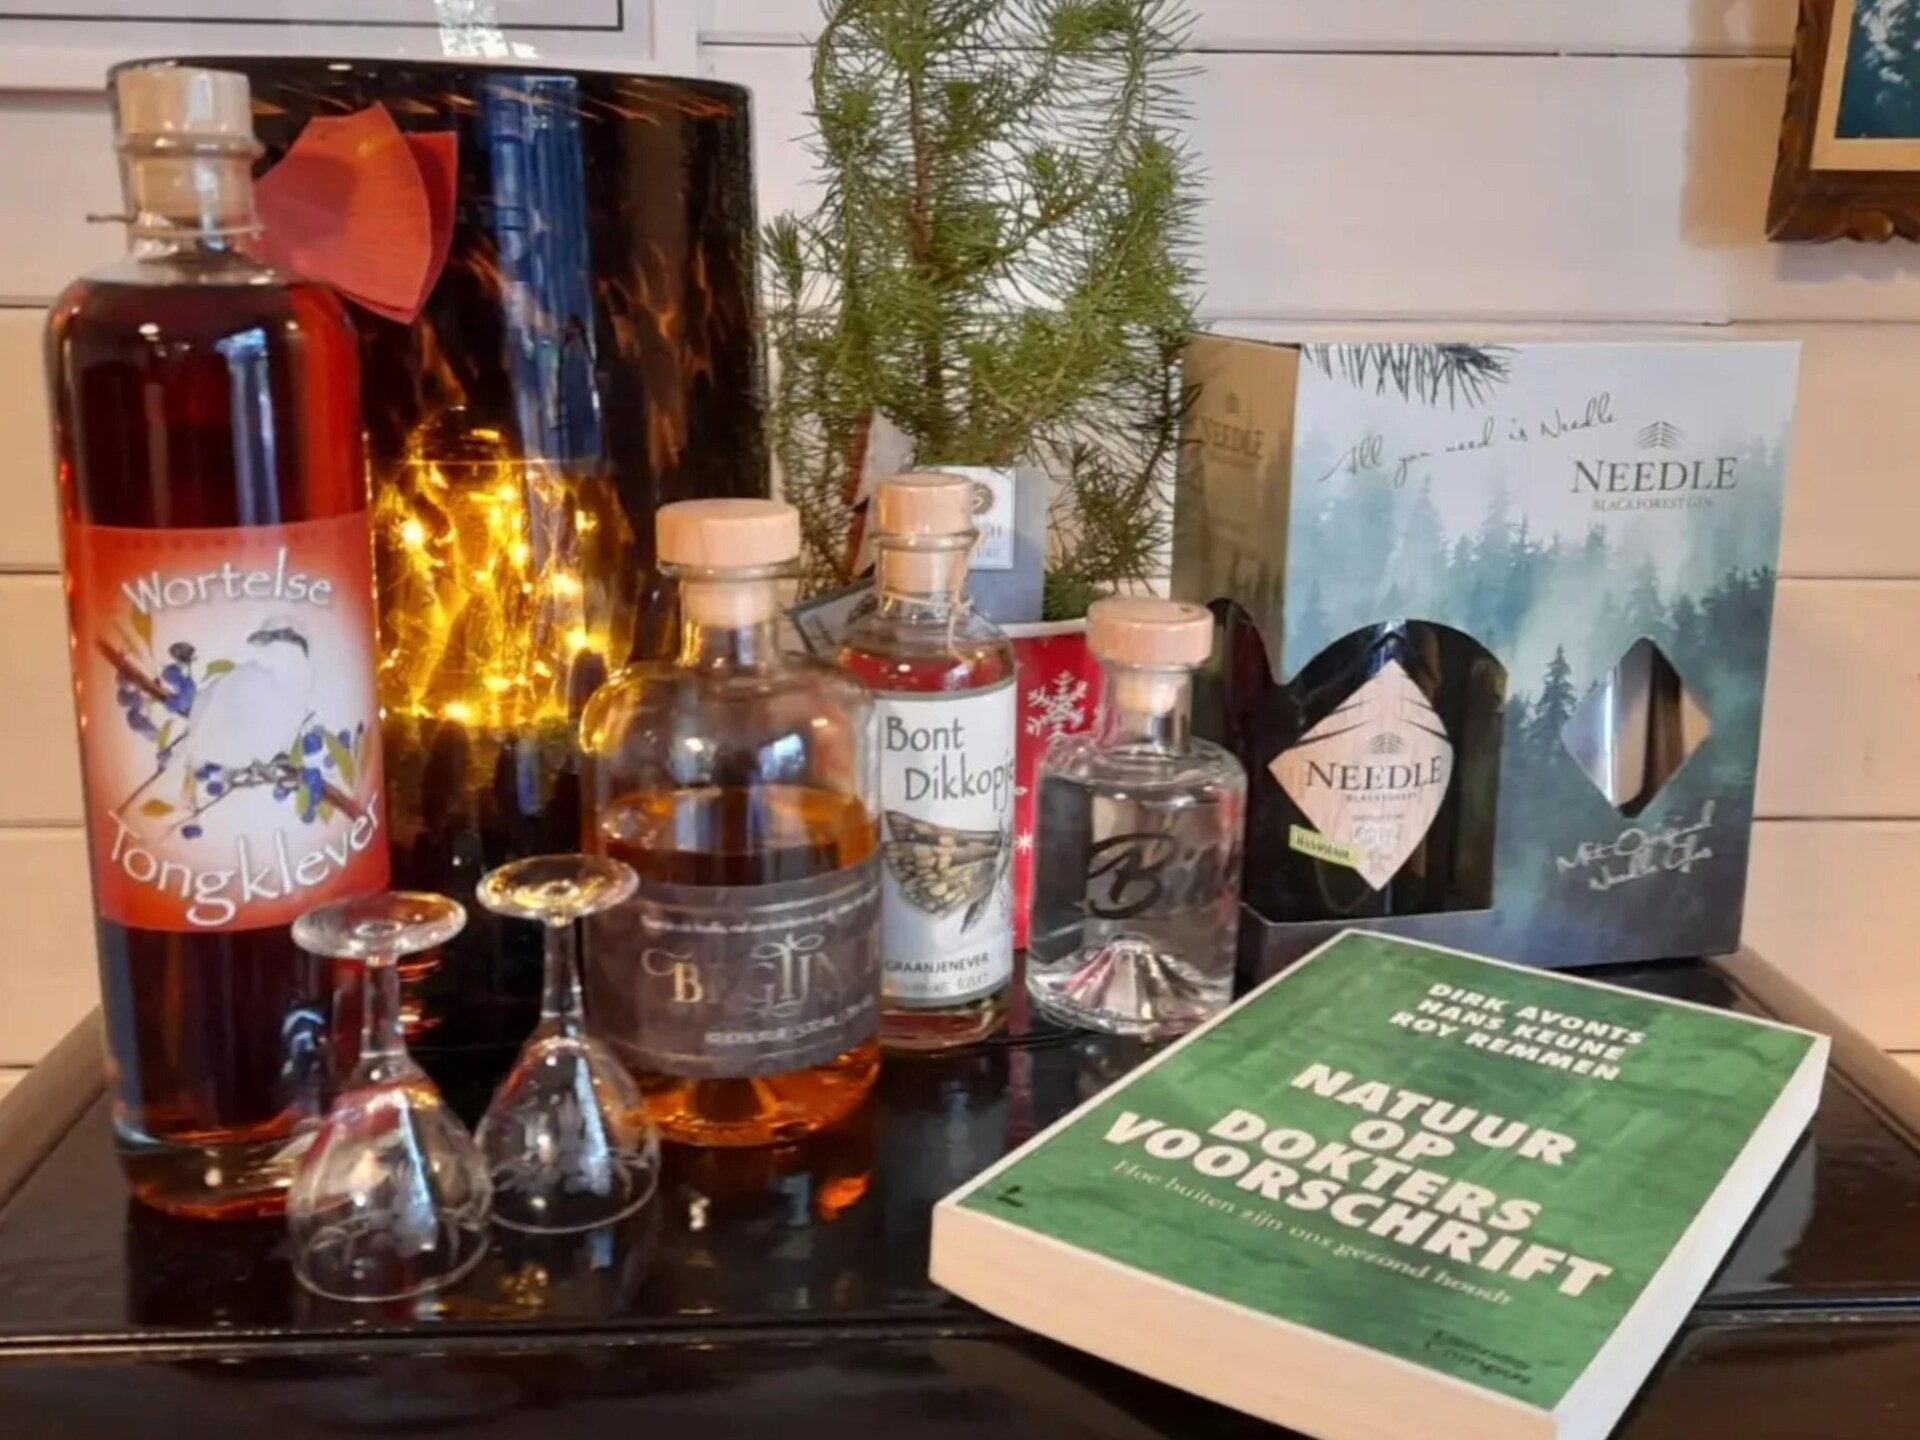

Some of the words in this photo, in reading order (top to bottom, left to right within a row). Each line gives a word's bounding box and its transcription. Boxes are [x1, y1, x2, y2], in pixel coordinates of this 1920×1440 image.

[1201, 416, 1265, 460] NEEDLE
[1540, 393, 1617, 438] Needle
[1570, 456, 1738, 493] NEEDLE
[121, 546, 334, 615] Wortelse
[885, 715, 965, 752] Bont
[1306, 755, 1445, 792] NEEDLE
[107, 793, 380, 927] Tongklever
[1417, 999, 1505, 1031] HANS
[1512, 1024, 1626, 1061] KEUNE
[1427, 983, 1509, 1013] DIRK
[1515, 1006, 1647, 1045] AVONTS
[1389, 1011, 1459, 1038] ROY
[1464, 1032, 1621, 1081] REMMEN
[1290, 1063, 1577, 1167] NATUUR
[1349, 1120, 1456, 1163] OP
[1207, 1109, 1542, 1232] DOKTERS
[1102, 1111, 1614, 1298] VOORSCHRIFT
[1240, 1206, 1284, 1231] zijn
